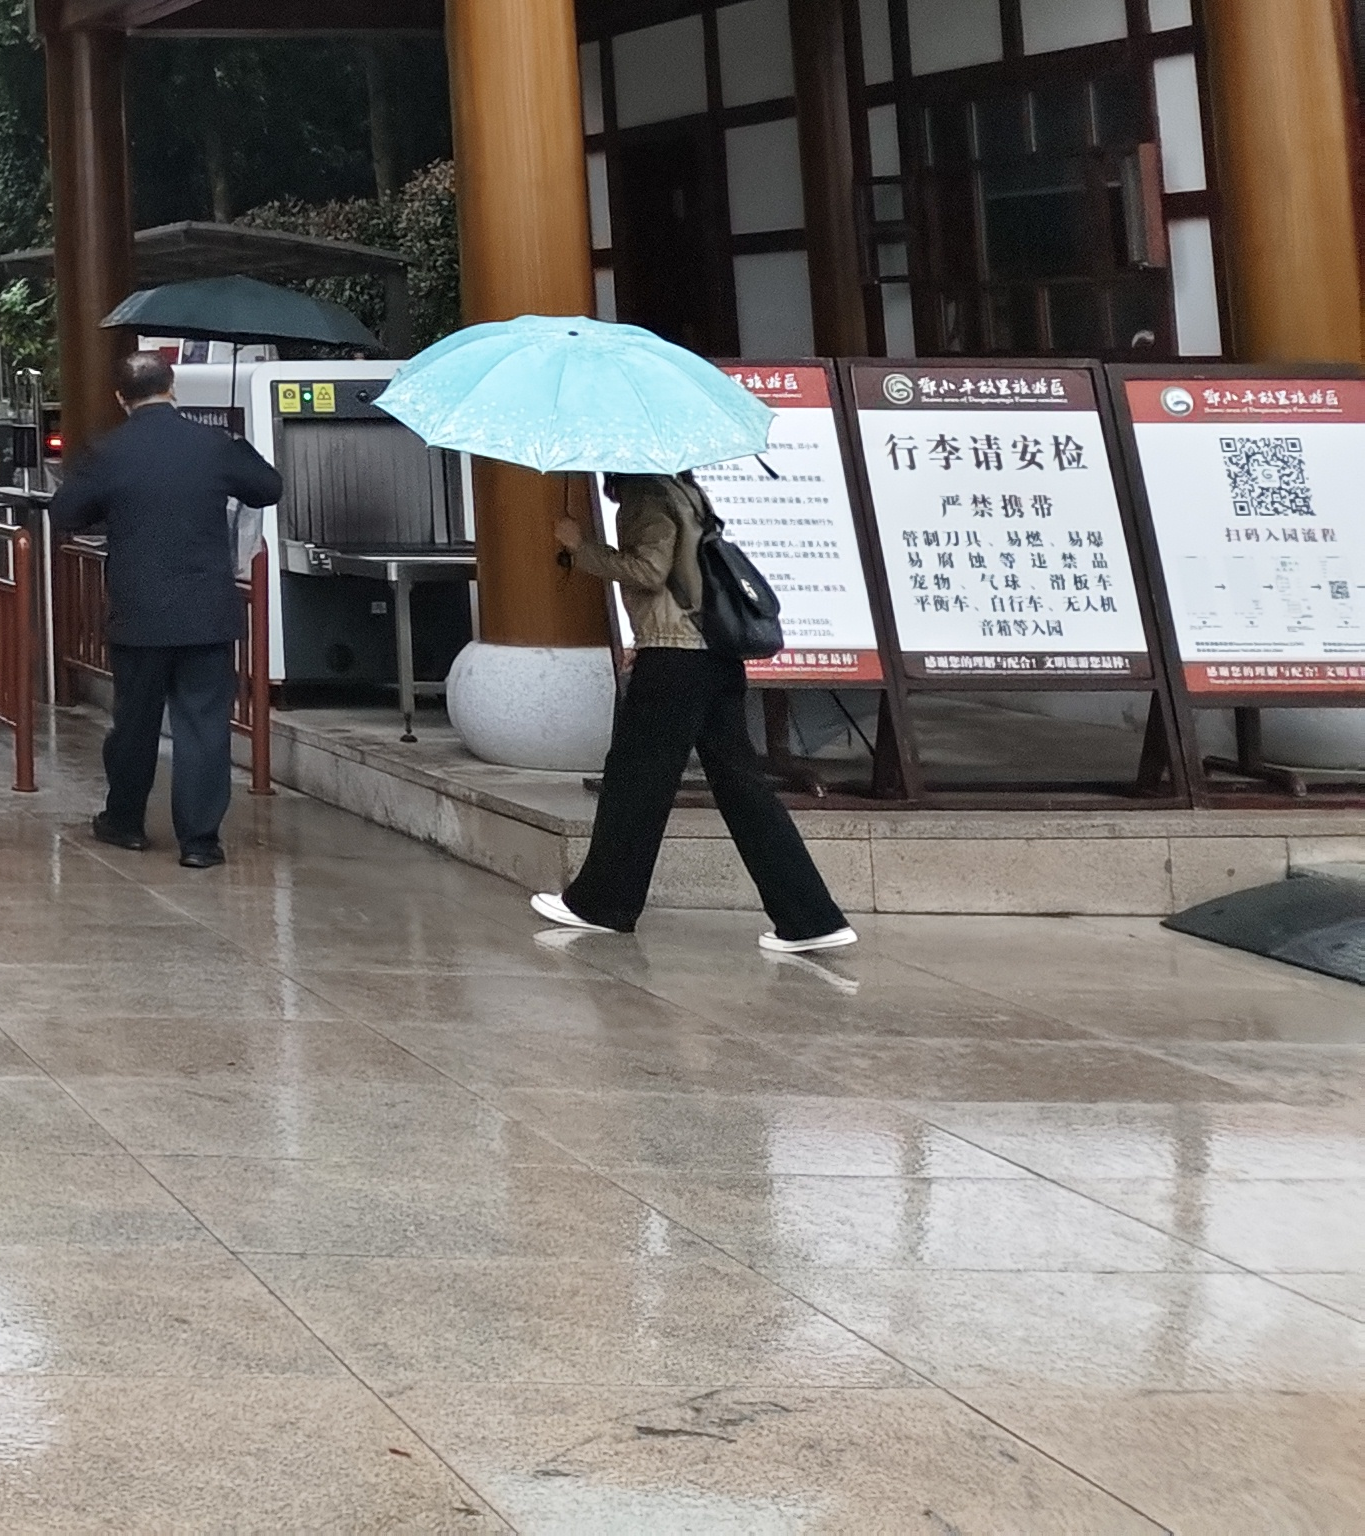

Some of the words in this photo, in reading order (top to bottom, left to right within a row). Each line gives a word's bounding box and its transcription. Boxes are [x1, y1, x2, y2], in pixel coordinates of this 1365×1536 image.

[885, 433, 1088, 471] 行李请安检
[940, 494, 1053, 518] 严禁携带
[1225, 527, 1337, 542] 扫码入园流程
[979, 619, 1064, 637] 音箱等入园
